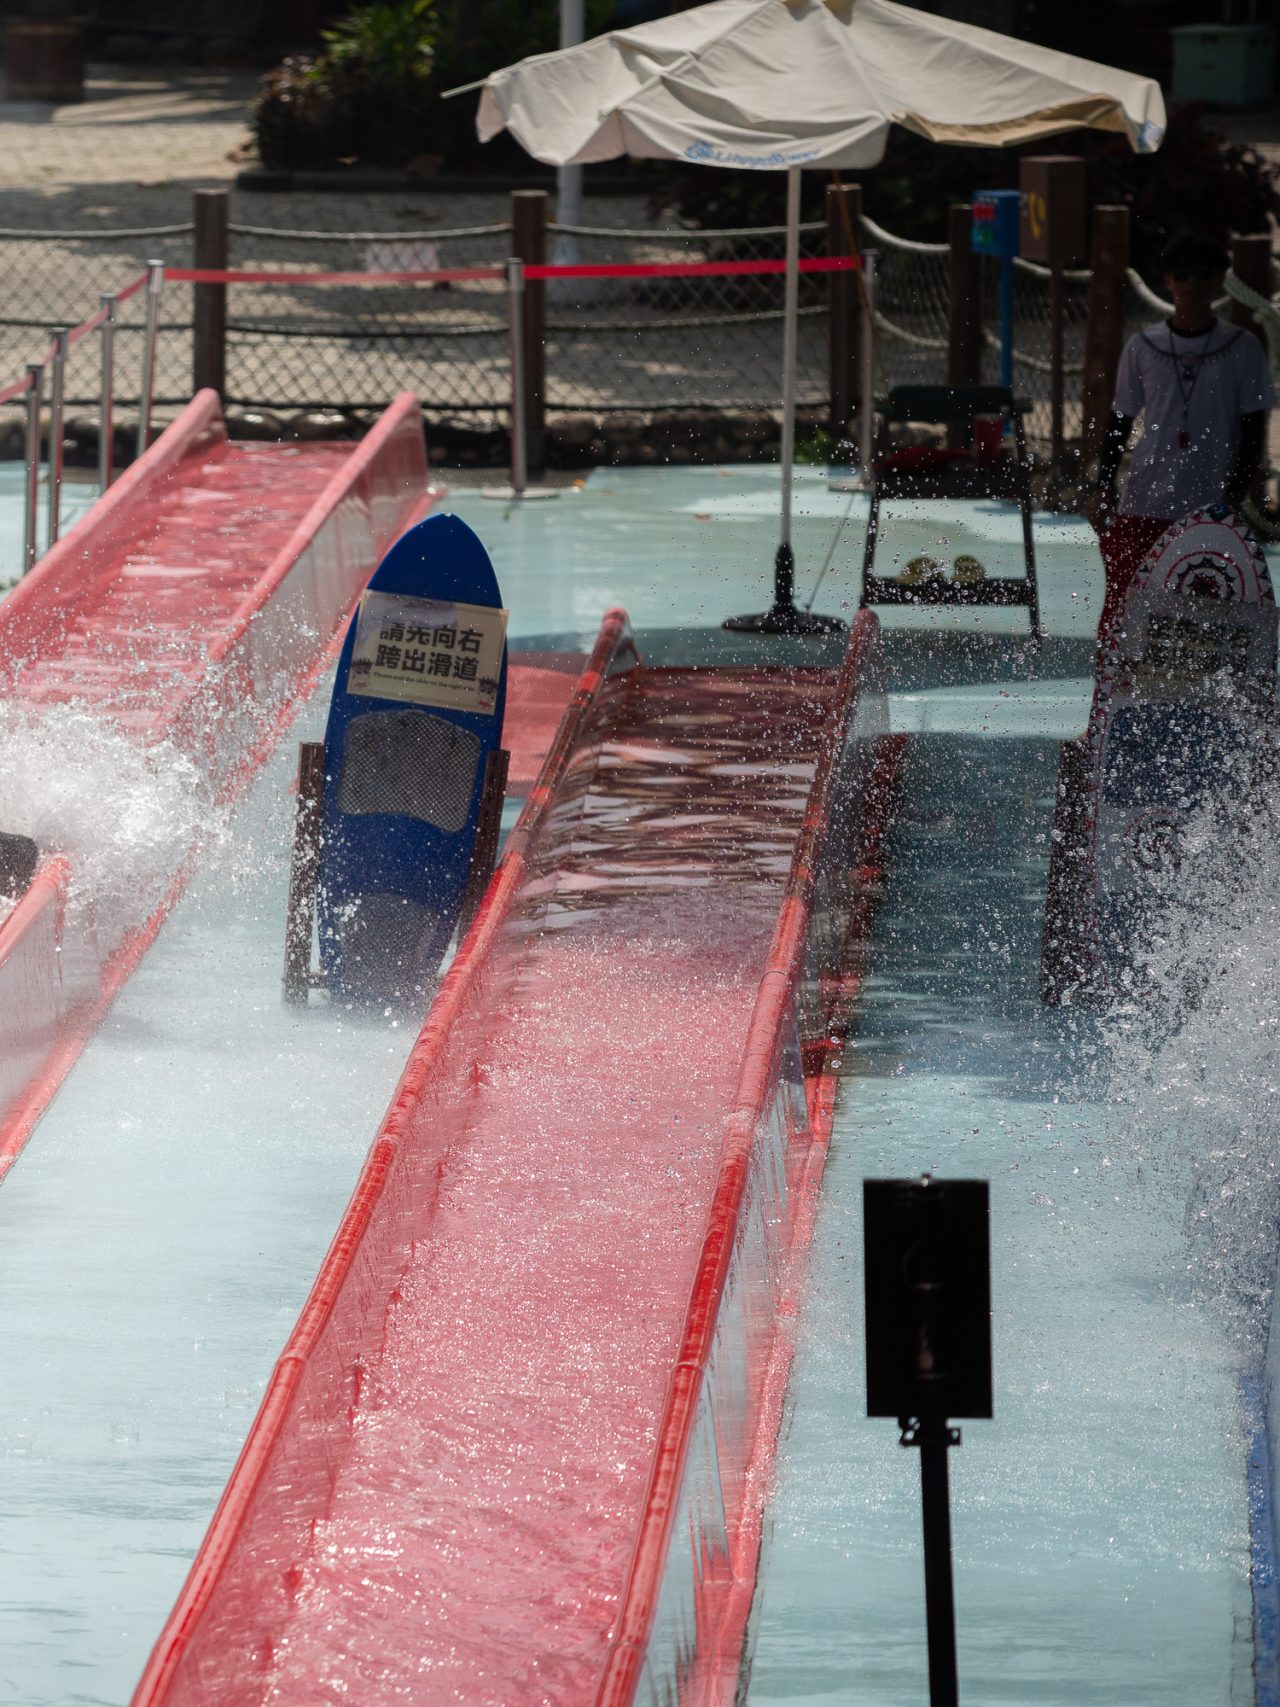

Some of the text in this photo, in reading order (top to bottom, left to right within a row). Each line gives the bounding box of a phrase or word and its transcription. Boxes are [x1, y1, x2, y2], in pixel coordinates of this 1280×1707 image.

[380, 619, 484, 654] 請先向右
[375, 644, 479, 682] 跨出滑道
